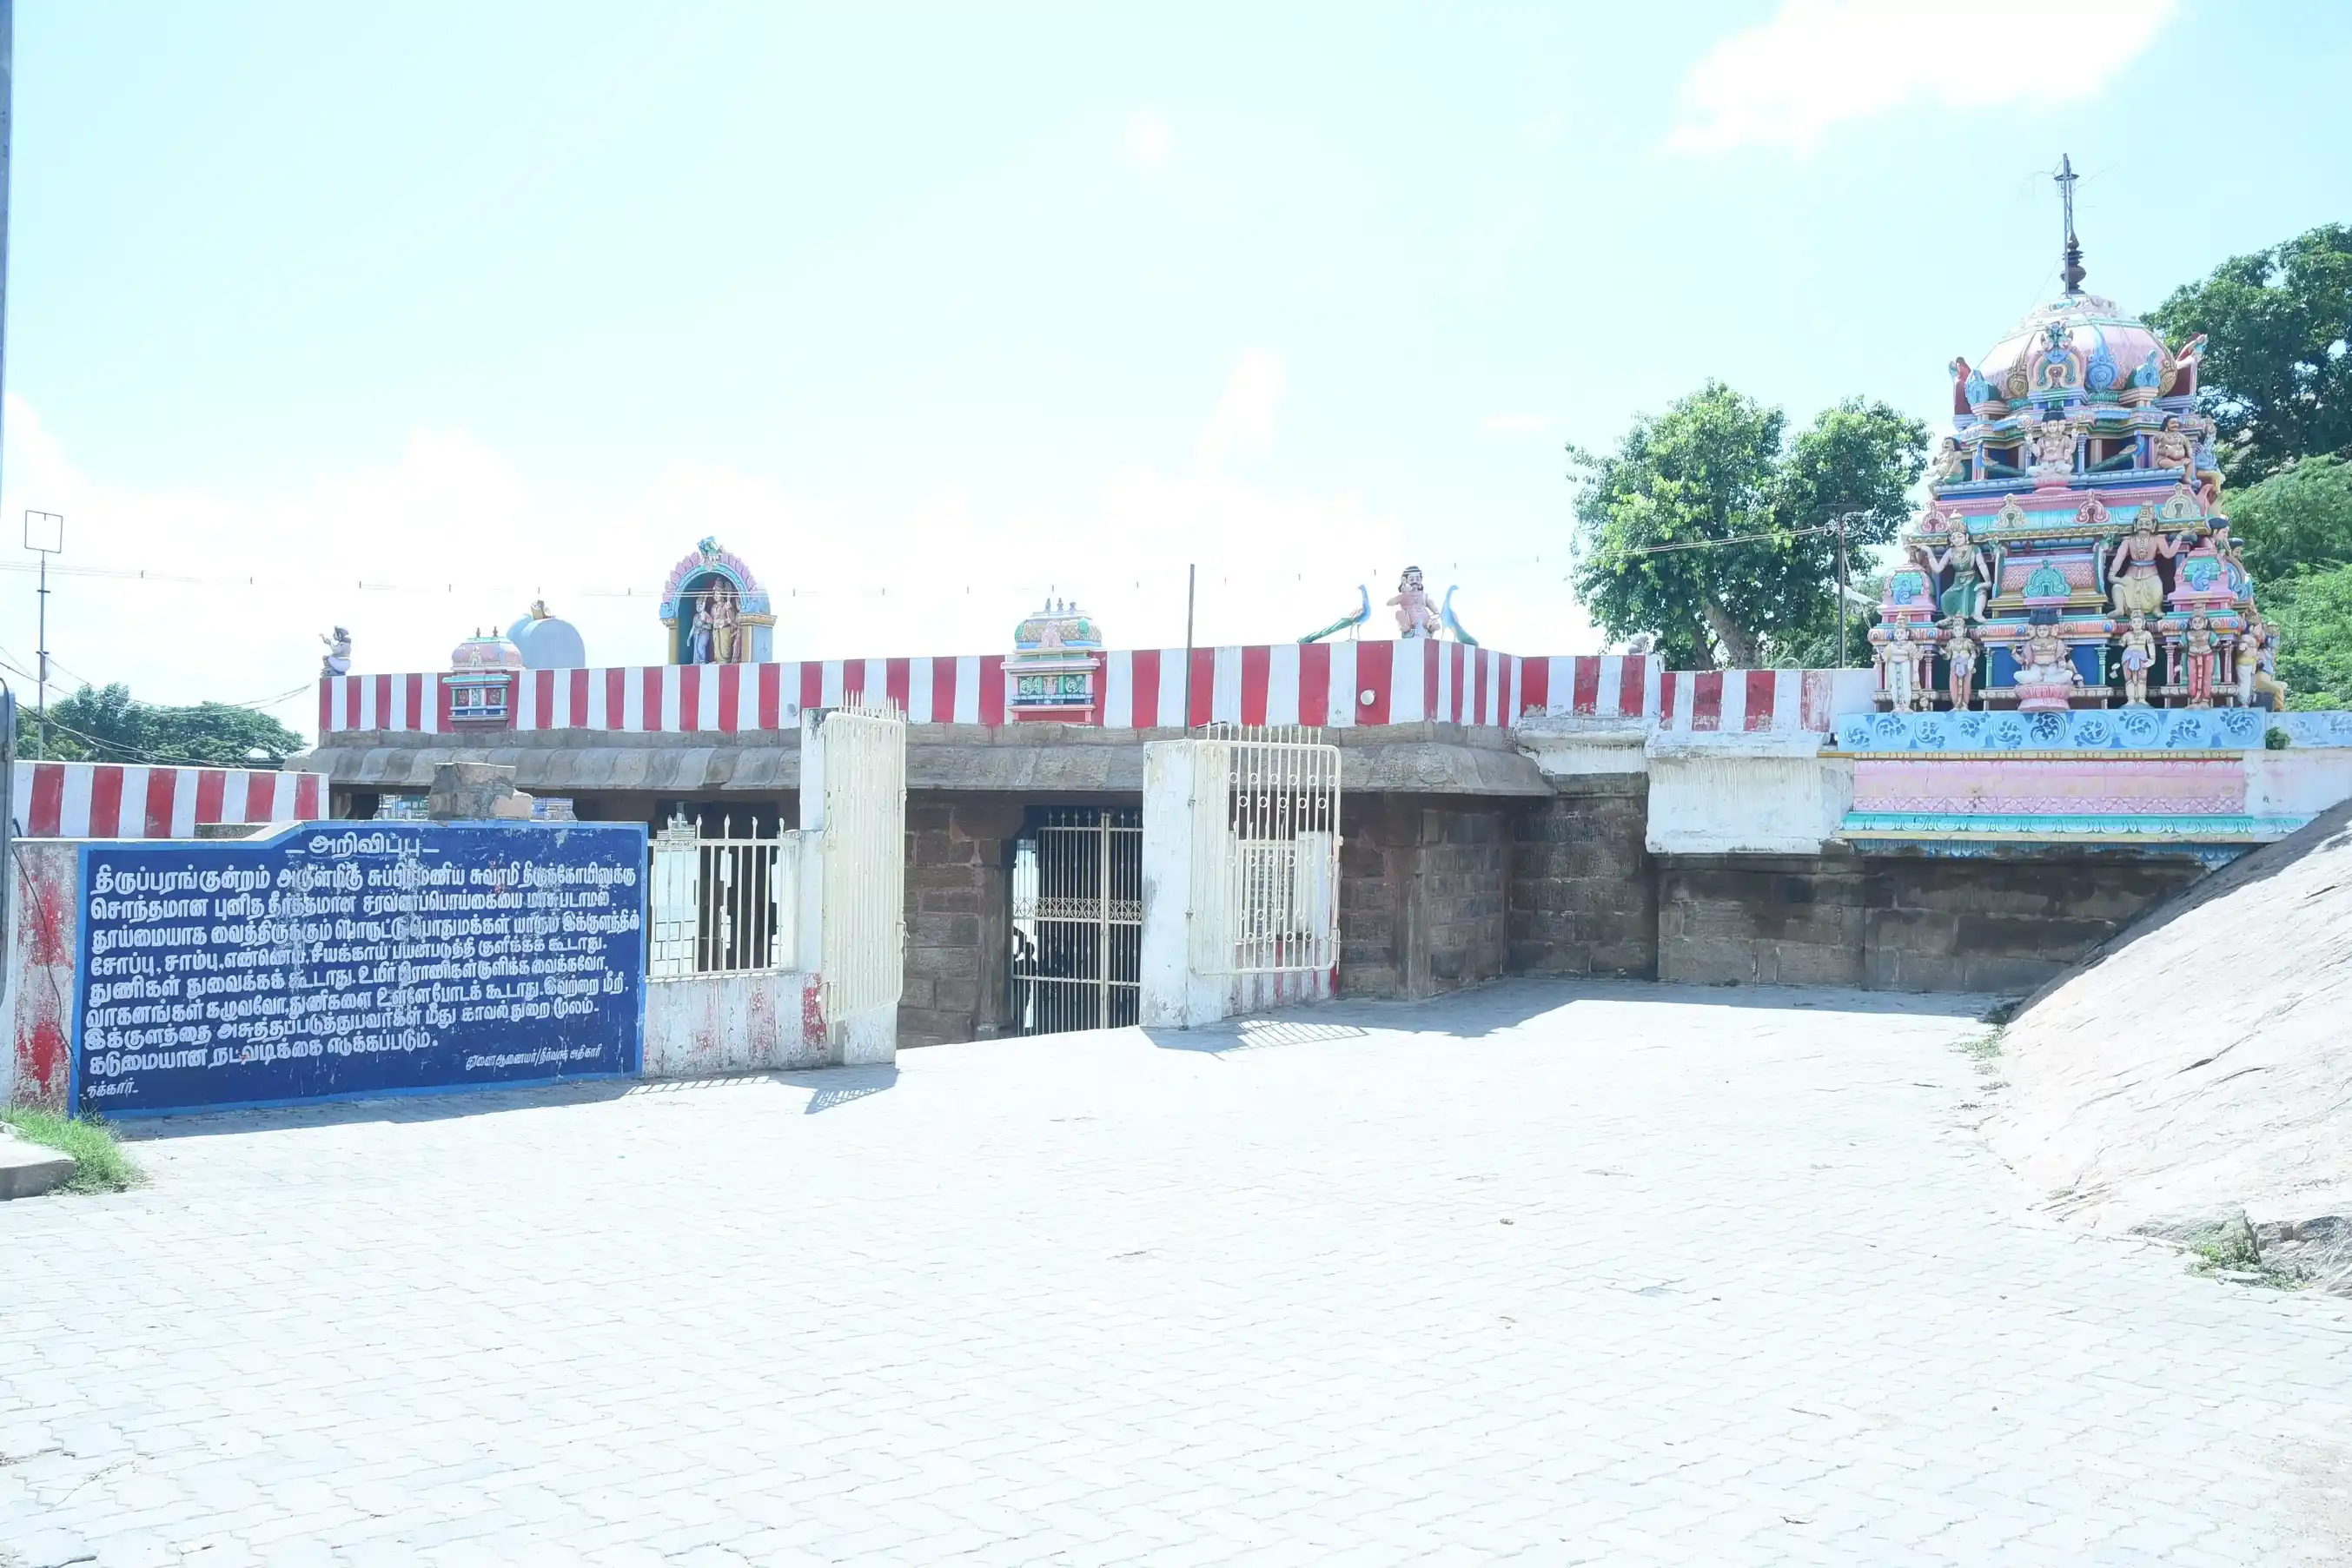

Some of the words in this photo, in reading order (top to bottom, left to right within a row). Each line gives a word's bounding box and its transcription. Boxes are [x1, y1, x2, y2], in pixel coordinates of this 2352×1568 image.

[89, 863, 271, 896] திருப்பரங்குன்றம்
[90, 893, 209, 923] சொந்தமான
[215, 892, 265, 921] புனித
[91, 924, 208, 955] தூய்மையாக
[210, 918, 333, 948] வைத்திருக்கும்
[89, 974, 182, 1008] துணிகள்
[186, 968, 285, 999] துவைக்கக்
[84, 1023, 213, 1052] இக்குளத்தை
[425, 1002, 457, 1029] மீது
[85, 998, 204, 1029] வாகனங்கள்
[89, 1049, 209, 1078] கடுமையான
